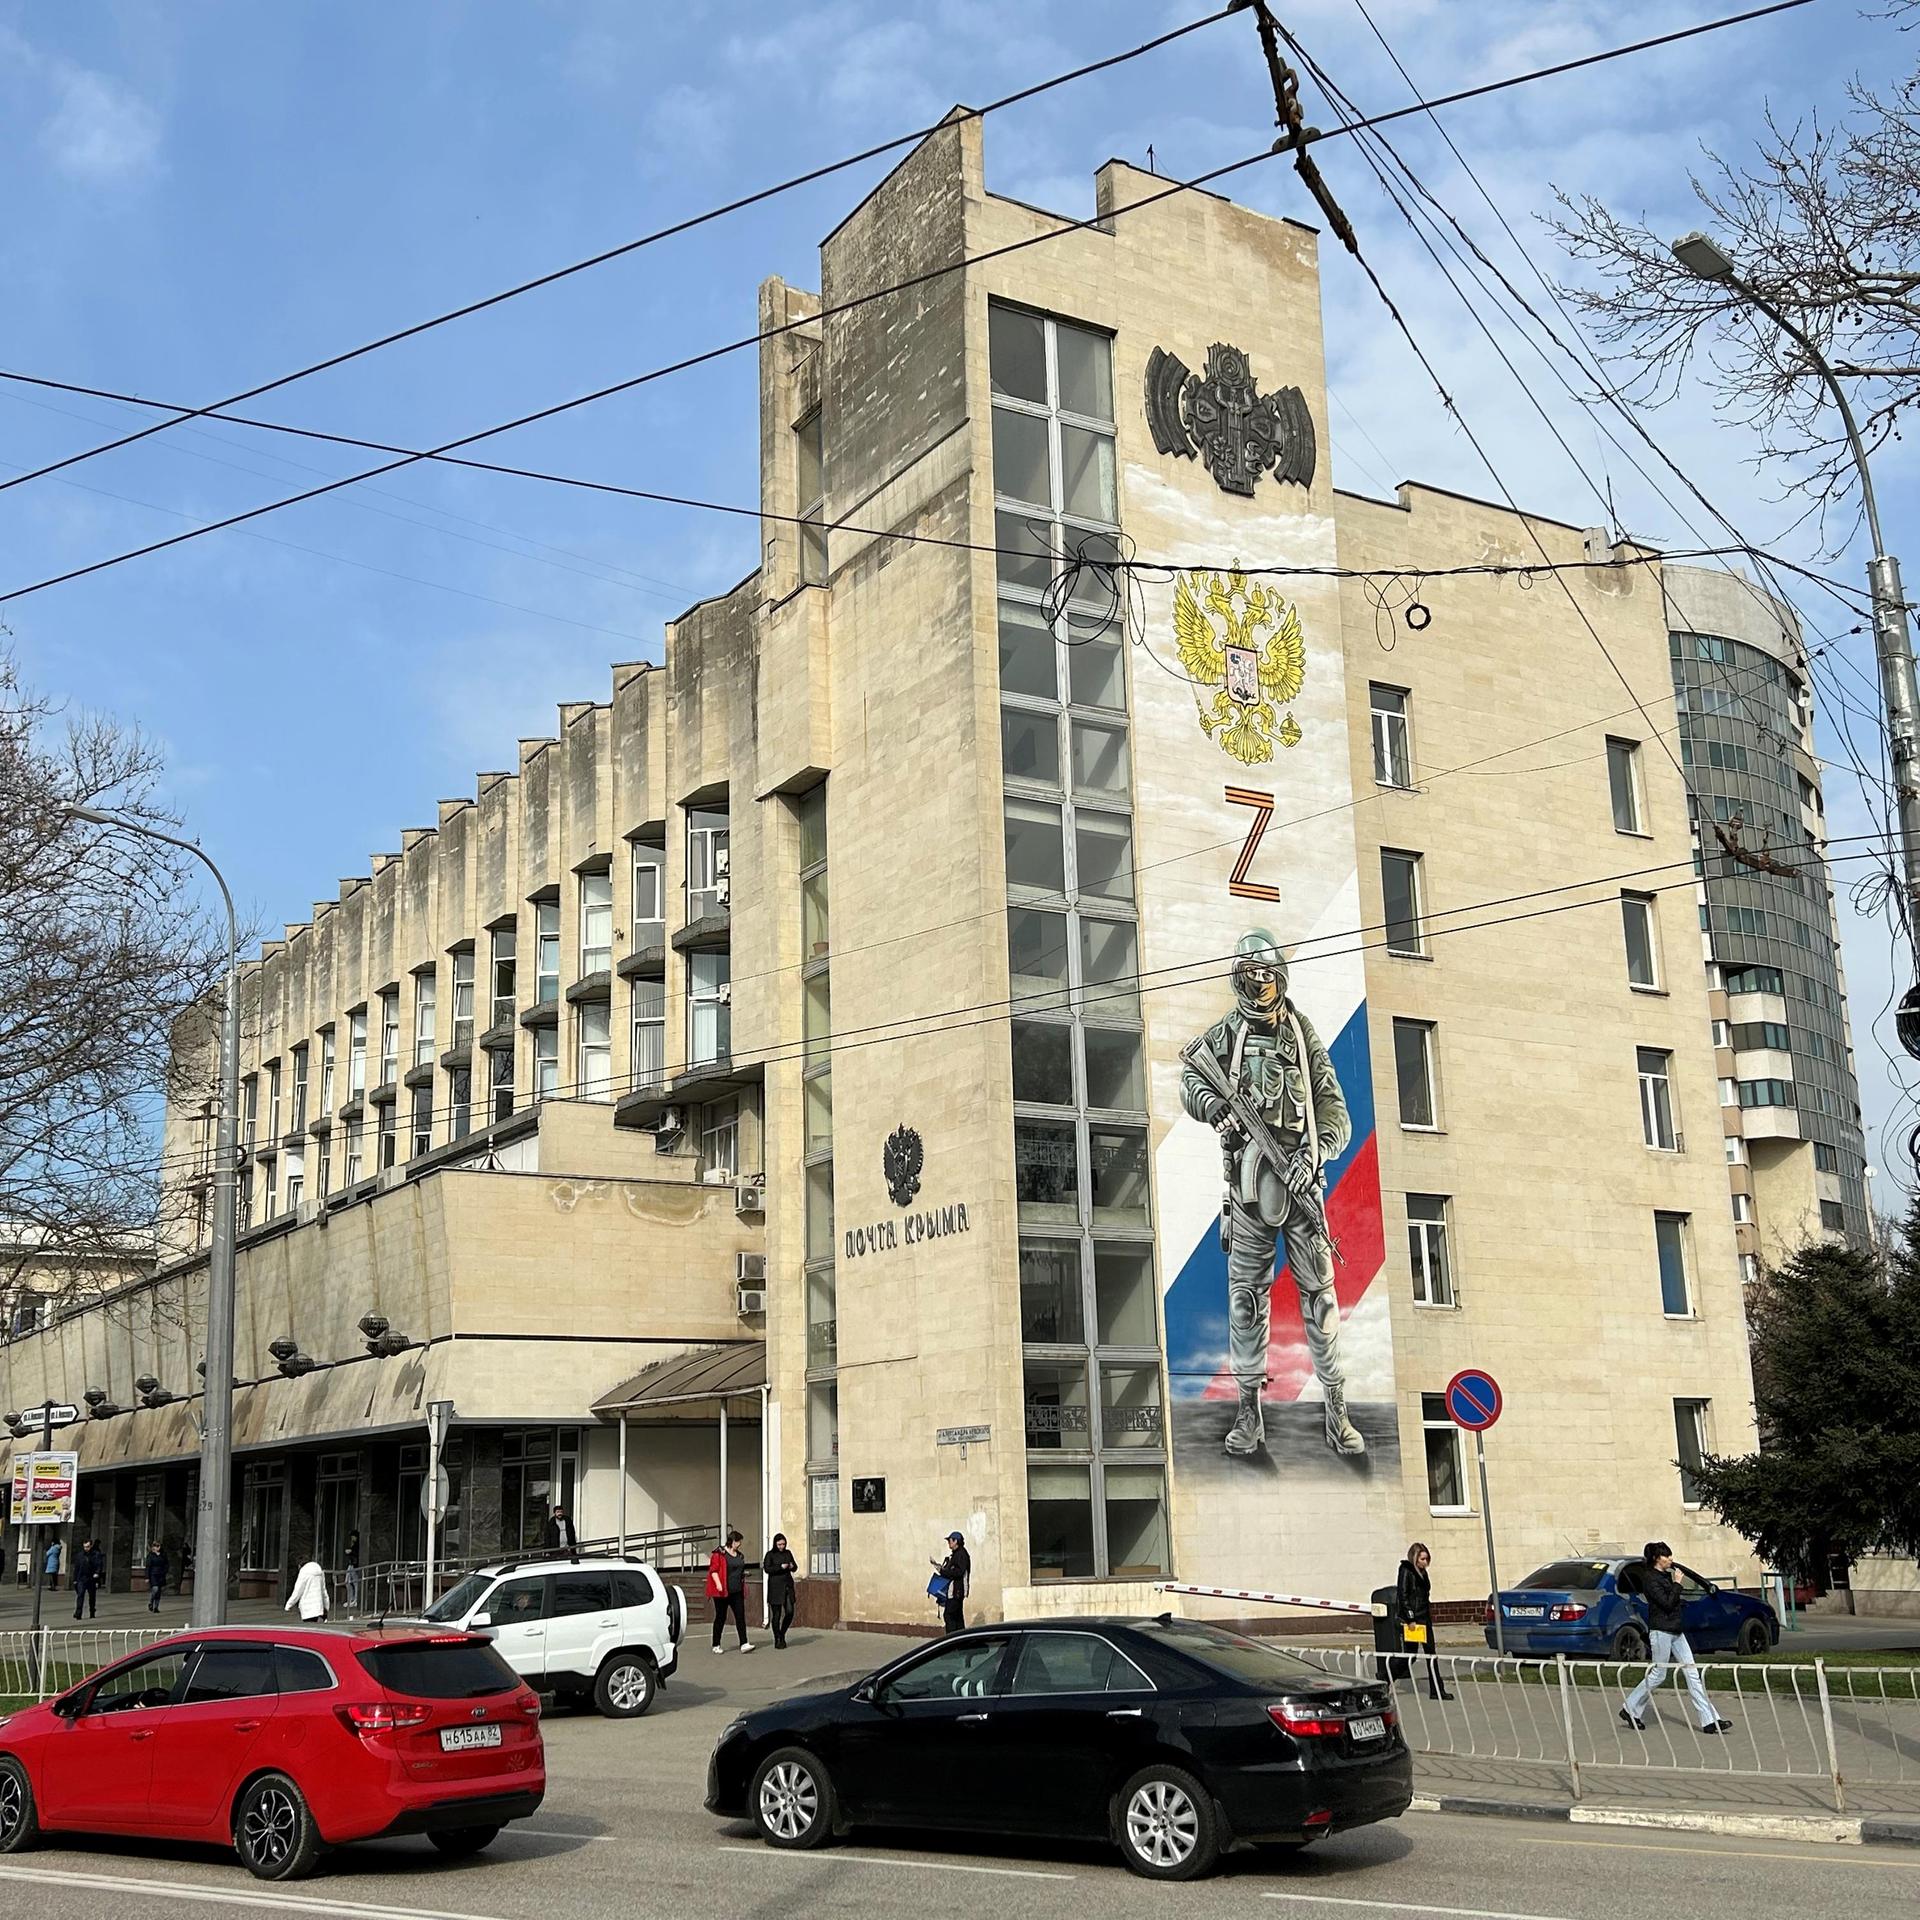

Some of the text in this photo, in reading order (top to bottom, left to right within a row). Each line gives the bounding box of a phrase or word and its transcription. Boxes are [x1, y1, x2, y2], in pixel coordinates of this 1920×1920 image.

[1225, 785, 1280, 902] Z
[845, 1203, 970, 1259] ПОЧТА КРЫМА
[445, 1726, 498, 1745] Н615АА 82
